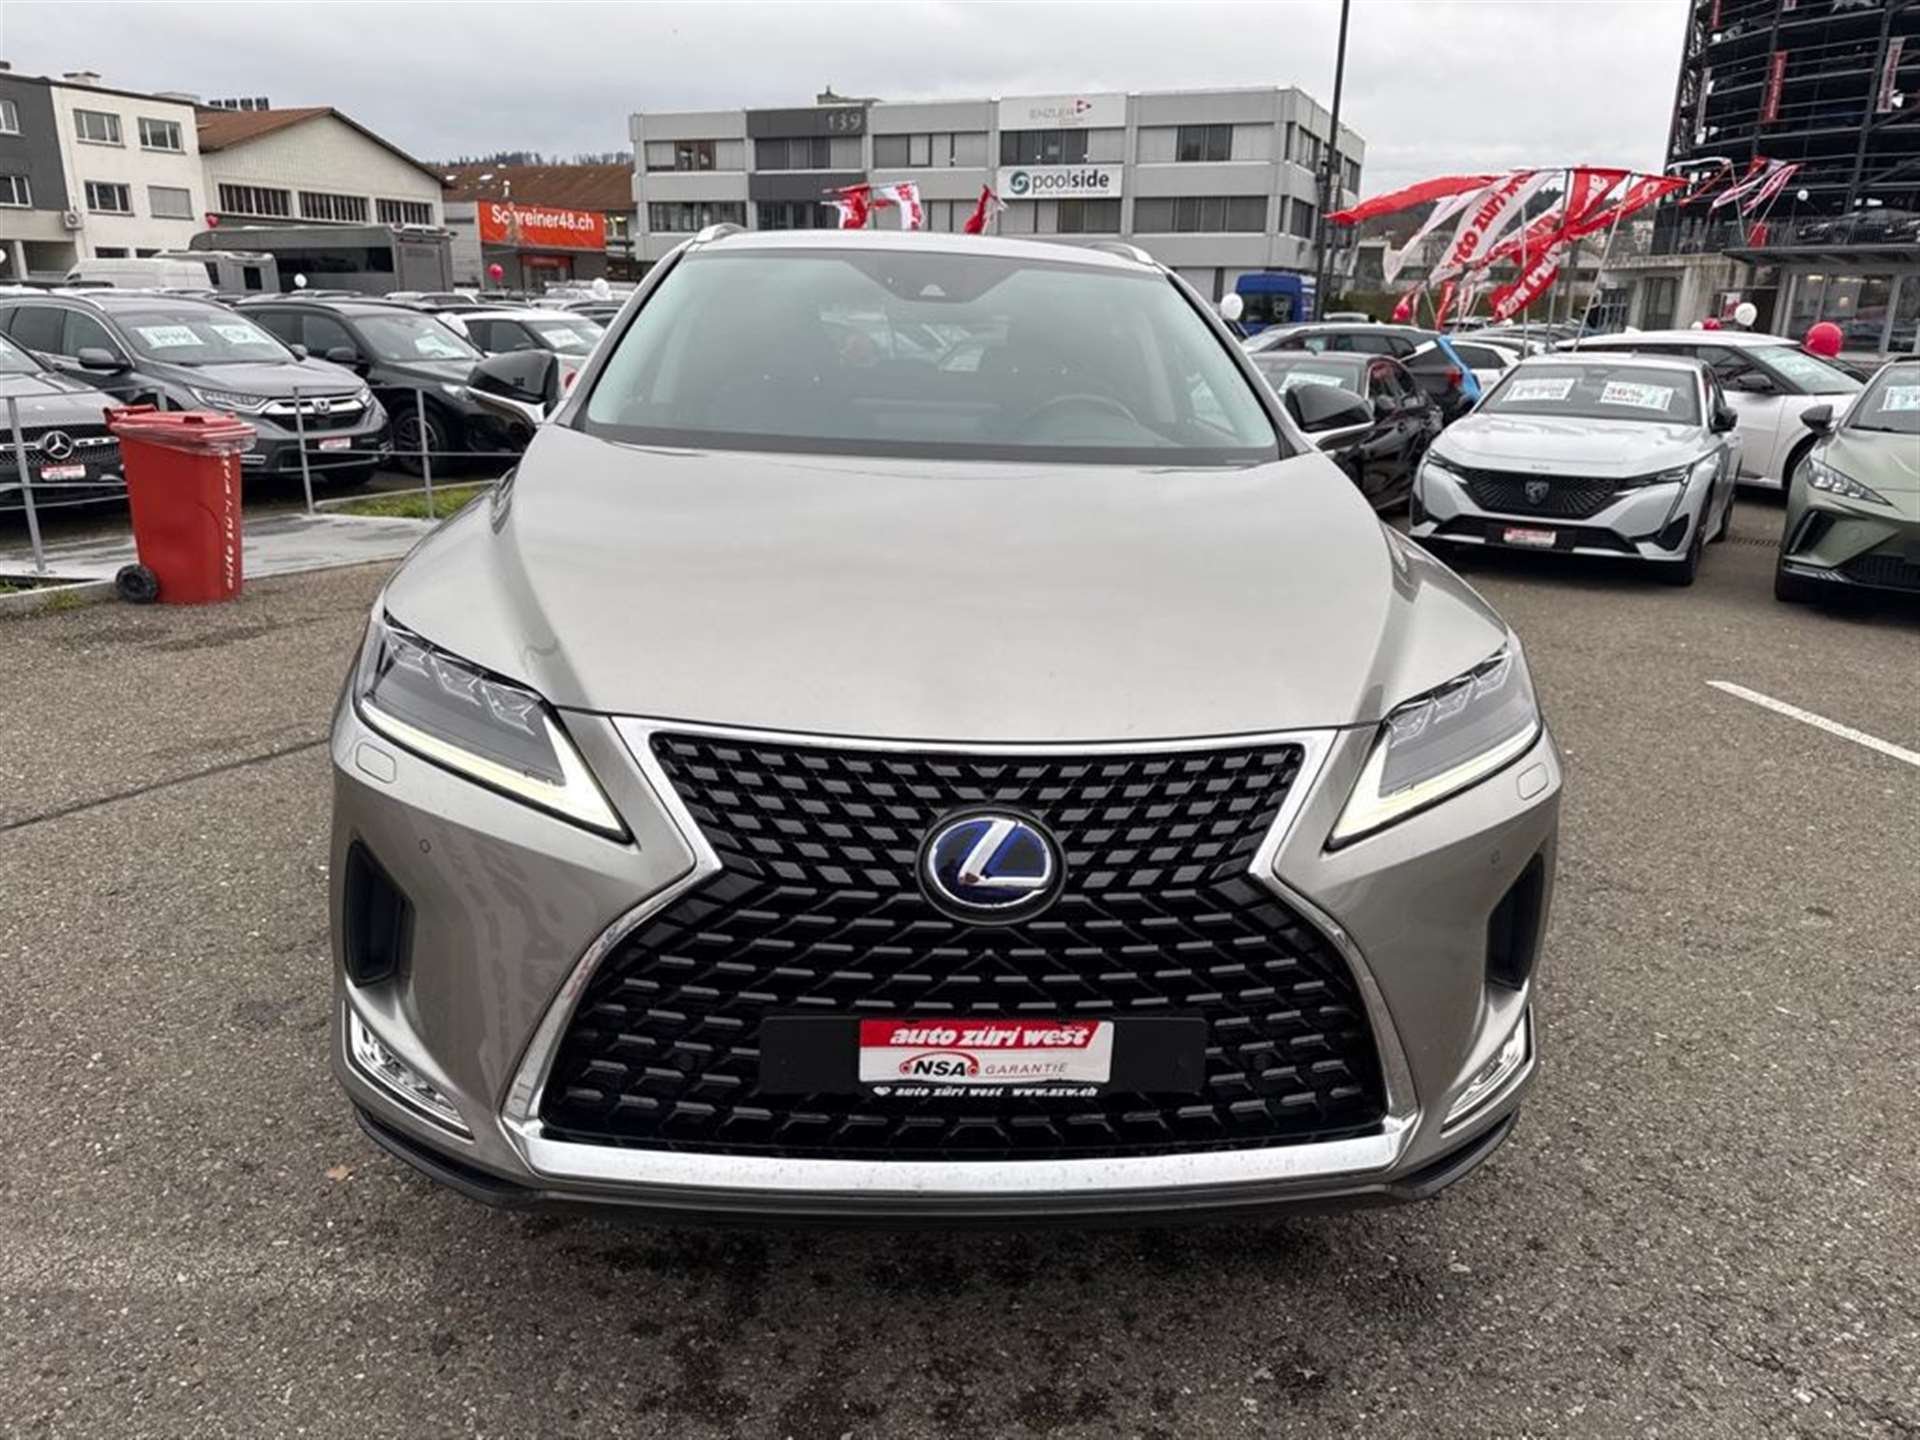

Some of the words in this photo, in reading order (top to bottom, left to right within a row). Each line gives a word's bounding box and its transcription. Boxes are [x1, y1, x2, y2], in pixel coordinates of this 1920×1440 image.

[828, 113, 862, 131] 139
[1031, 169, 1109, 195] poolside
[889, 1027, 957, 1045] auto
[958, 1026, 1021, 1046] züri
[1022, 1028, 1090, 1046] west
[913, 1060, 967, 1077] NSA
[984, 1062, 1069, 1075] GARANTIE
[895, 1086, 930, 1097] auto
[932, 1086, 967, 1097] züri
[968, 1086, 1004, 1097] west
